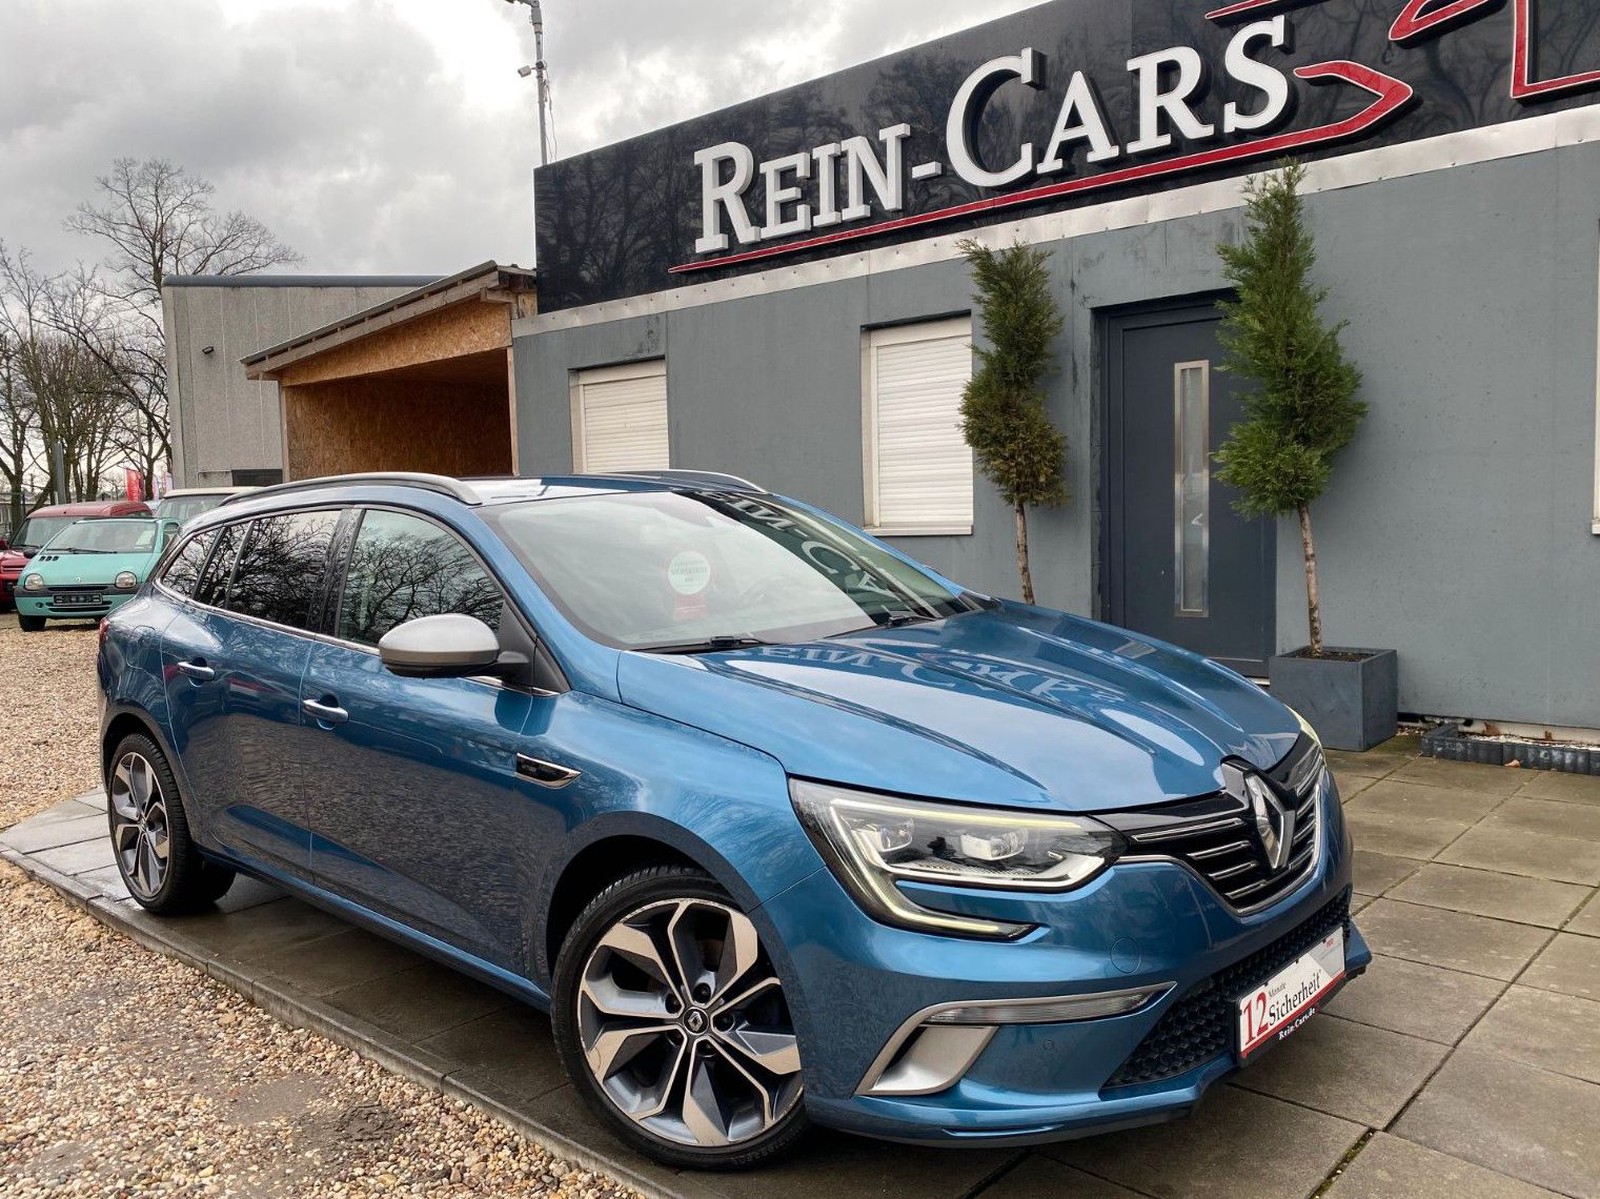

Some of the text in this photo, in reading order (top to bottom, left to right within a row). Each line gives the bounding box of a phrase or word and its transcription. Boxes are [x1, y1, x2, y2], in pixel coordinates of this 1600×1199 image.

[693, 14, 1290, 254] REIN-CARS
[1243, 971, 1320, 1046] 12 Sicherheit
